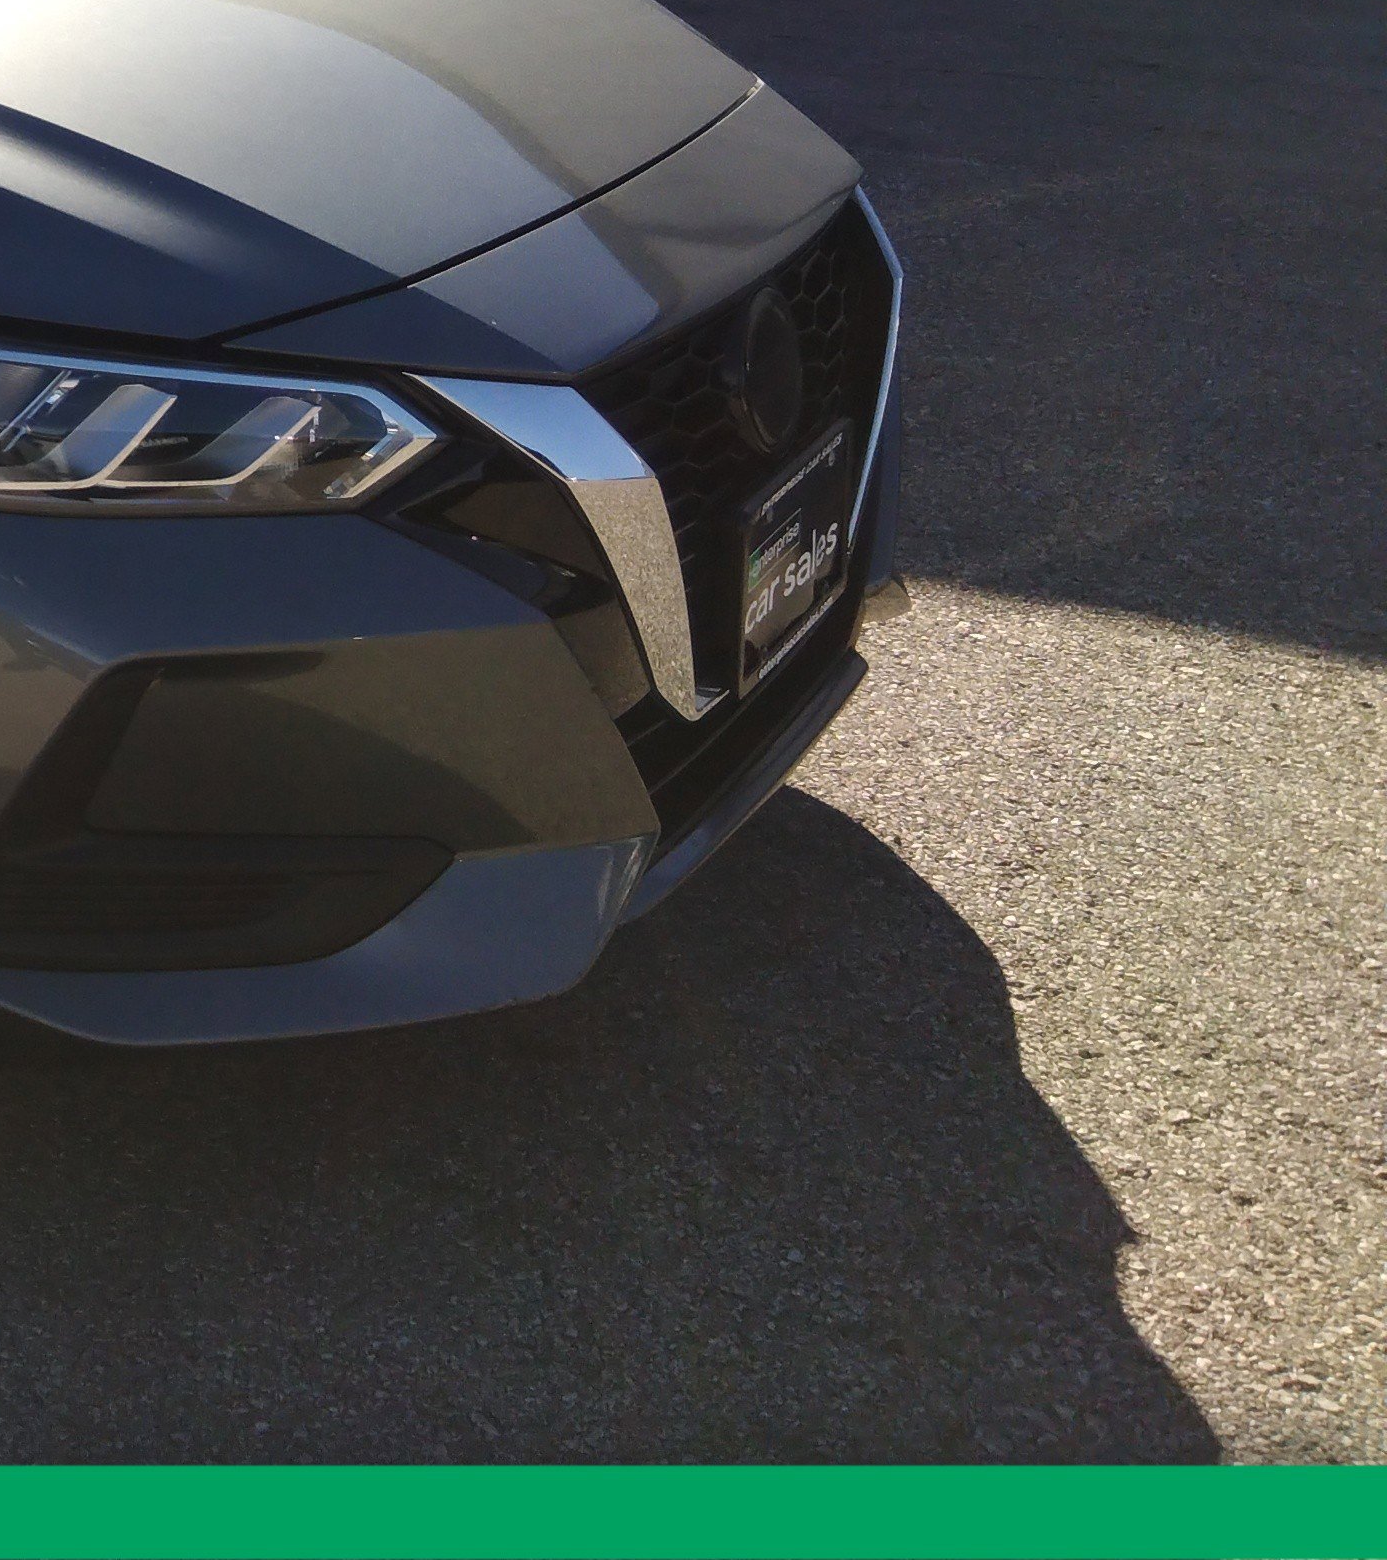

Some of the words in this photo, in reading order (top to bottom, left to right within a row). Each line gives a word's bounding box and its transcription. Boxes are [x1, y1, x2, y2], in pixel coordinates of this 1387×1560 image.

[745, 576, 780, 634] car
[784, 523, 838, 597] sales
[750, 522, 800, 578] enterprise
